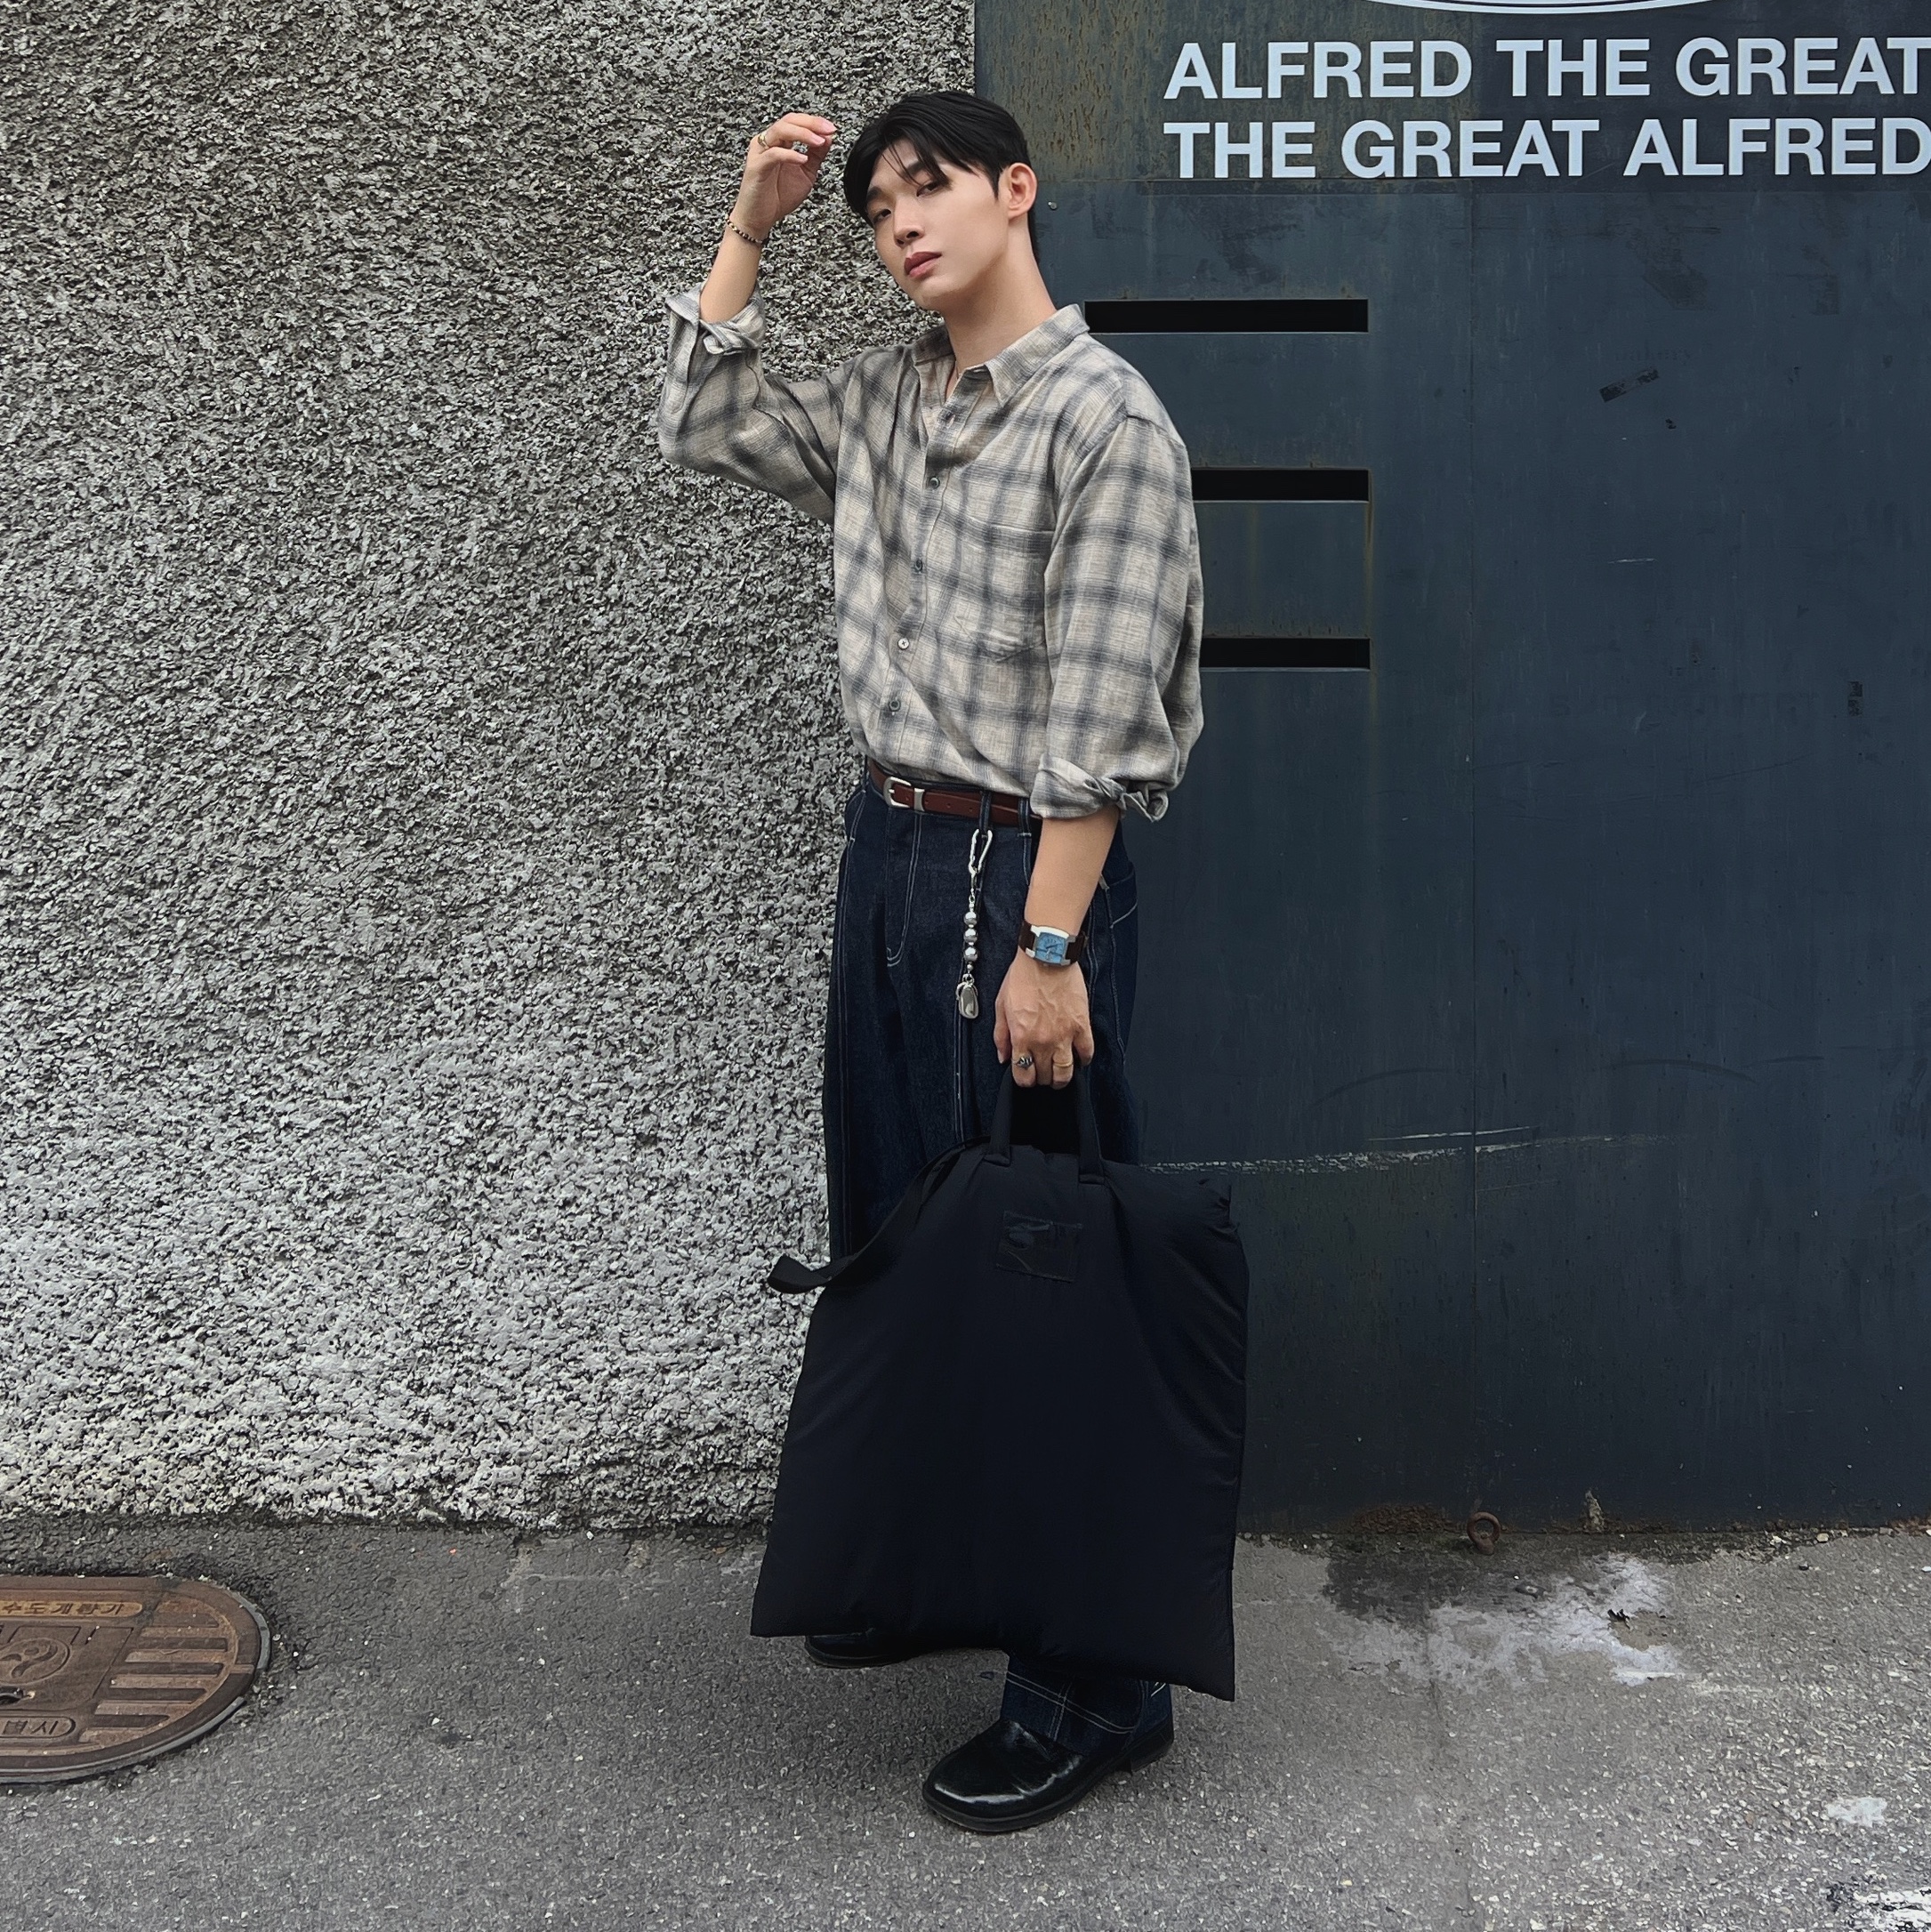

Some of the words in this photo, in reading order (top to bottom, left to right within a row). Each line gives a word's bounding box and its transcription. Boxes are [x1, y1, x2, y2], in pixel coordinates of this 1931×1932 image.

[1163, 40, 1473, 100] ALFRED
[1495, 38, 1651, 97] THE
[1675, 36, 1931, 96] GREAT
[1163, 122, 1316, 179] THE
[1341, 119, 1600, 178] GREAT
[1623, 117, 1931, 176] ALFRED
